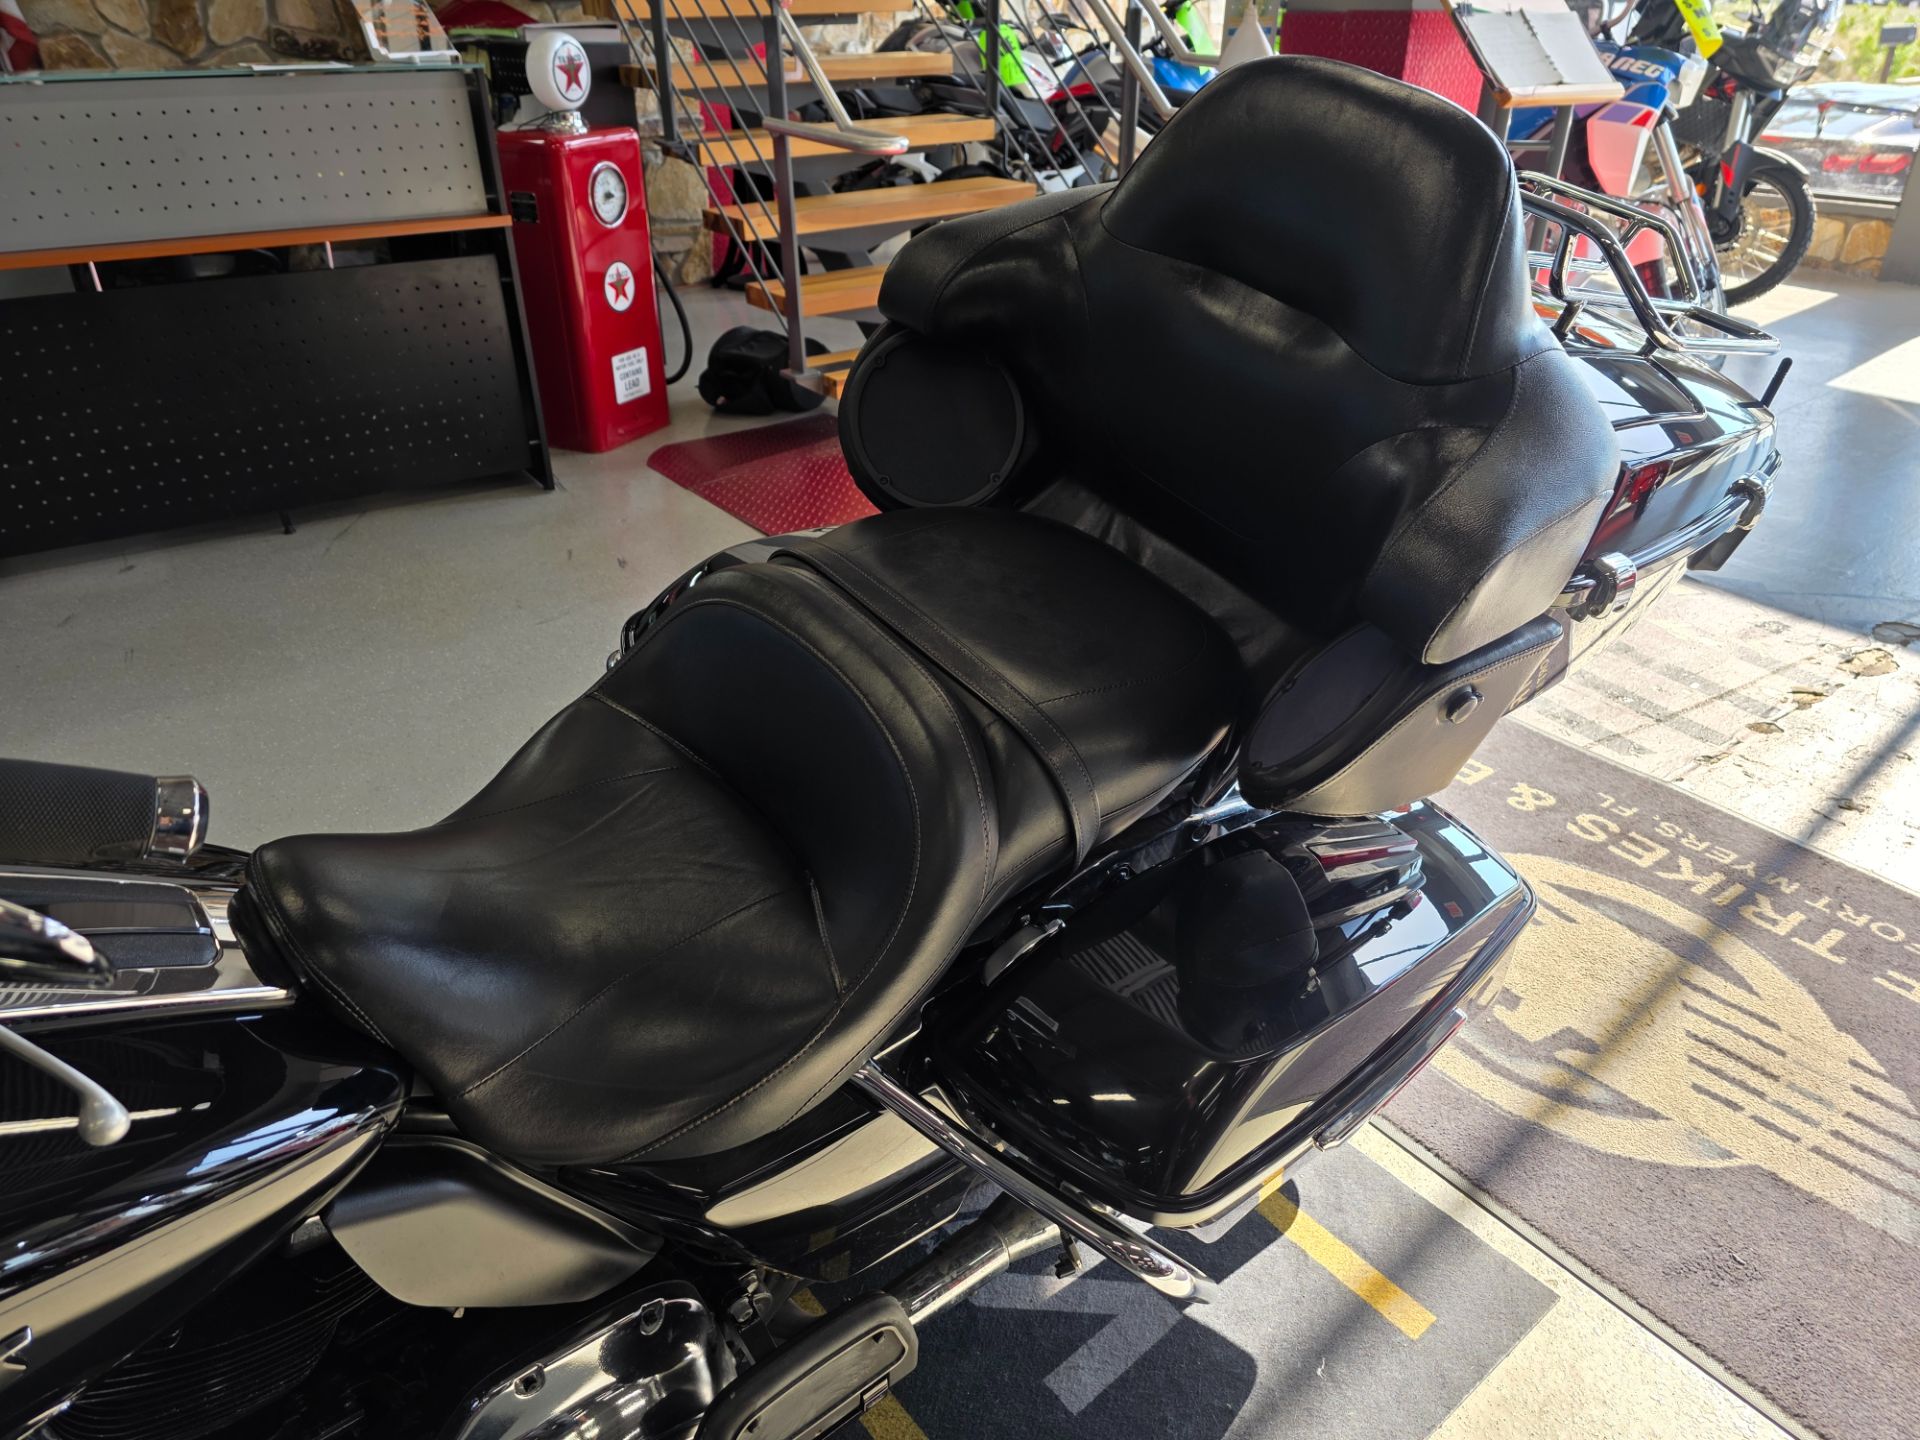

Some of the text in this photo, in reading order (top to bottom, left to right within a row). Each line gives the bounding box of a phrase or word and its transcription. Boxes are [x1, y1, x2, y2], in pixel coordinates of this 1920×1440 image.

[1598, 792, 1639, 817] FL
[1506, 782, 1848, 965] TRIKES &
